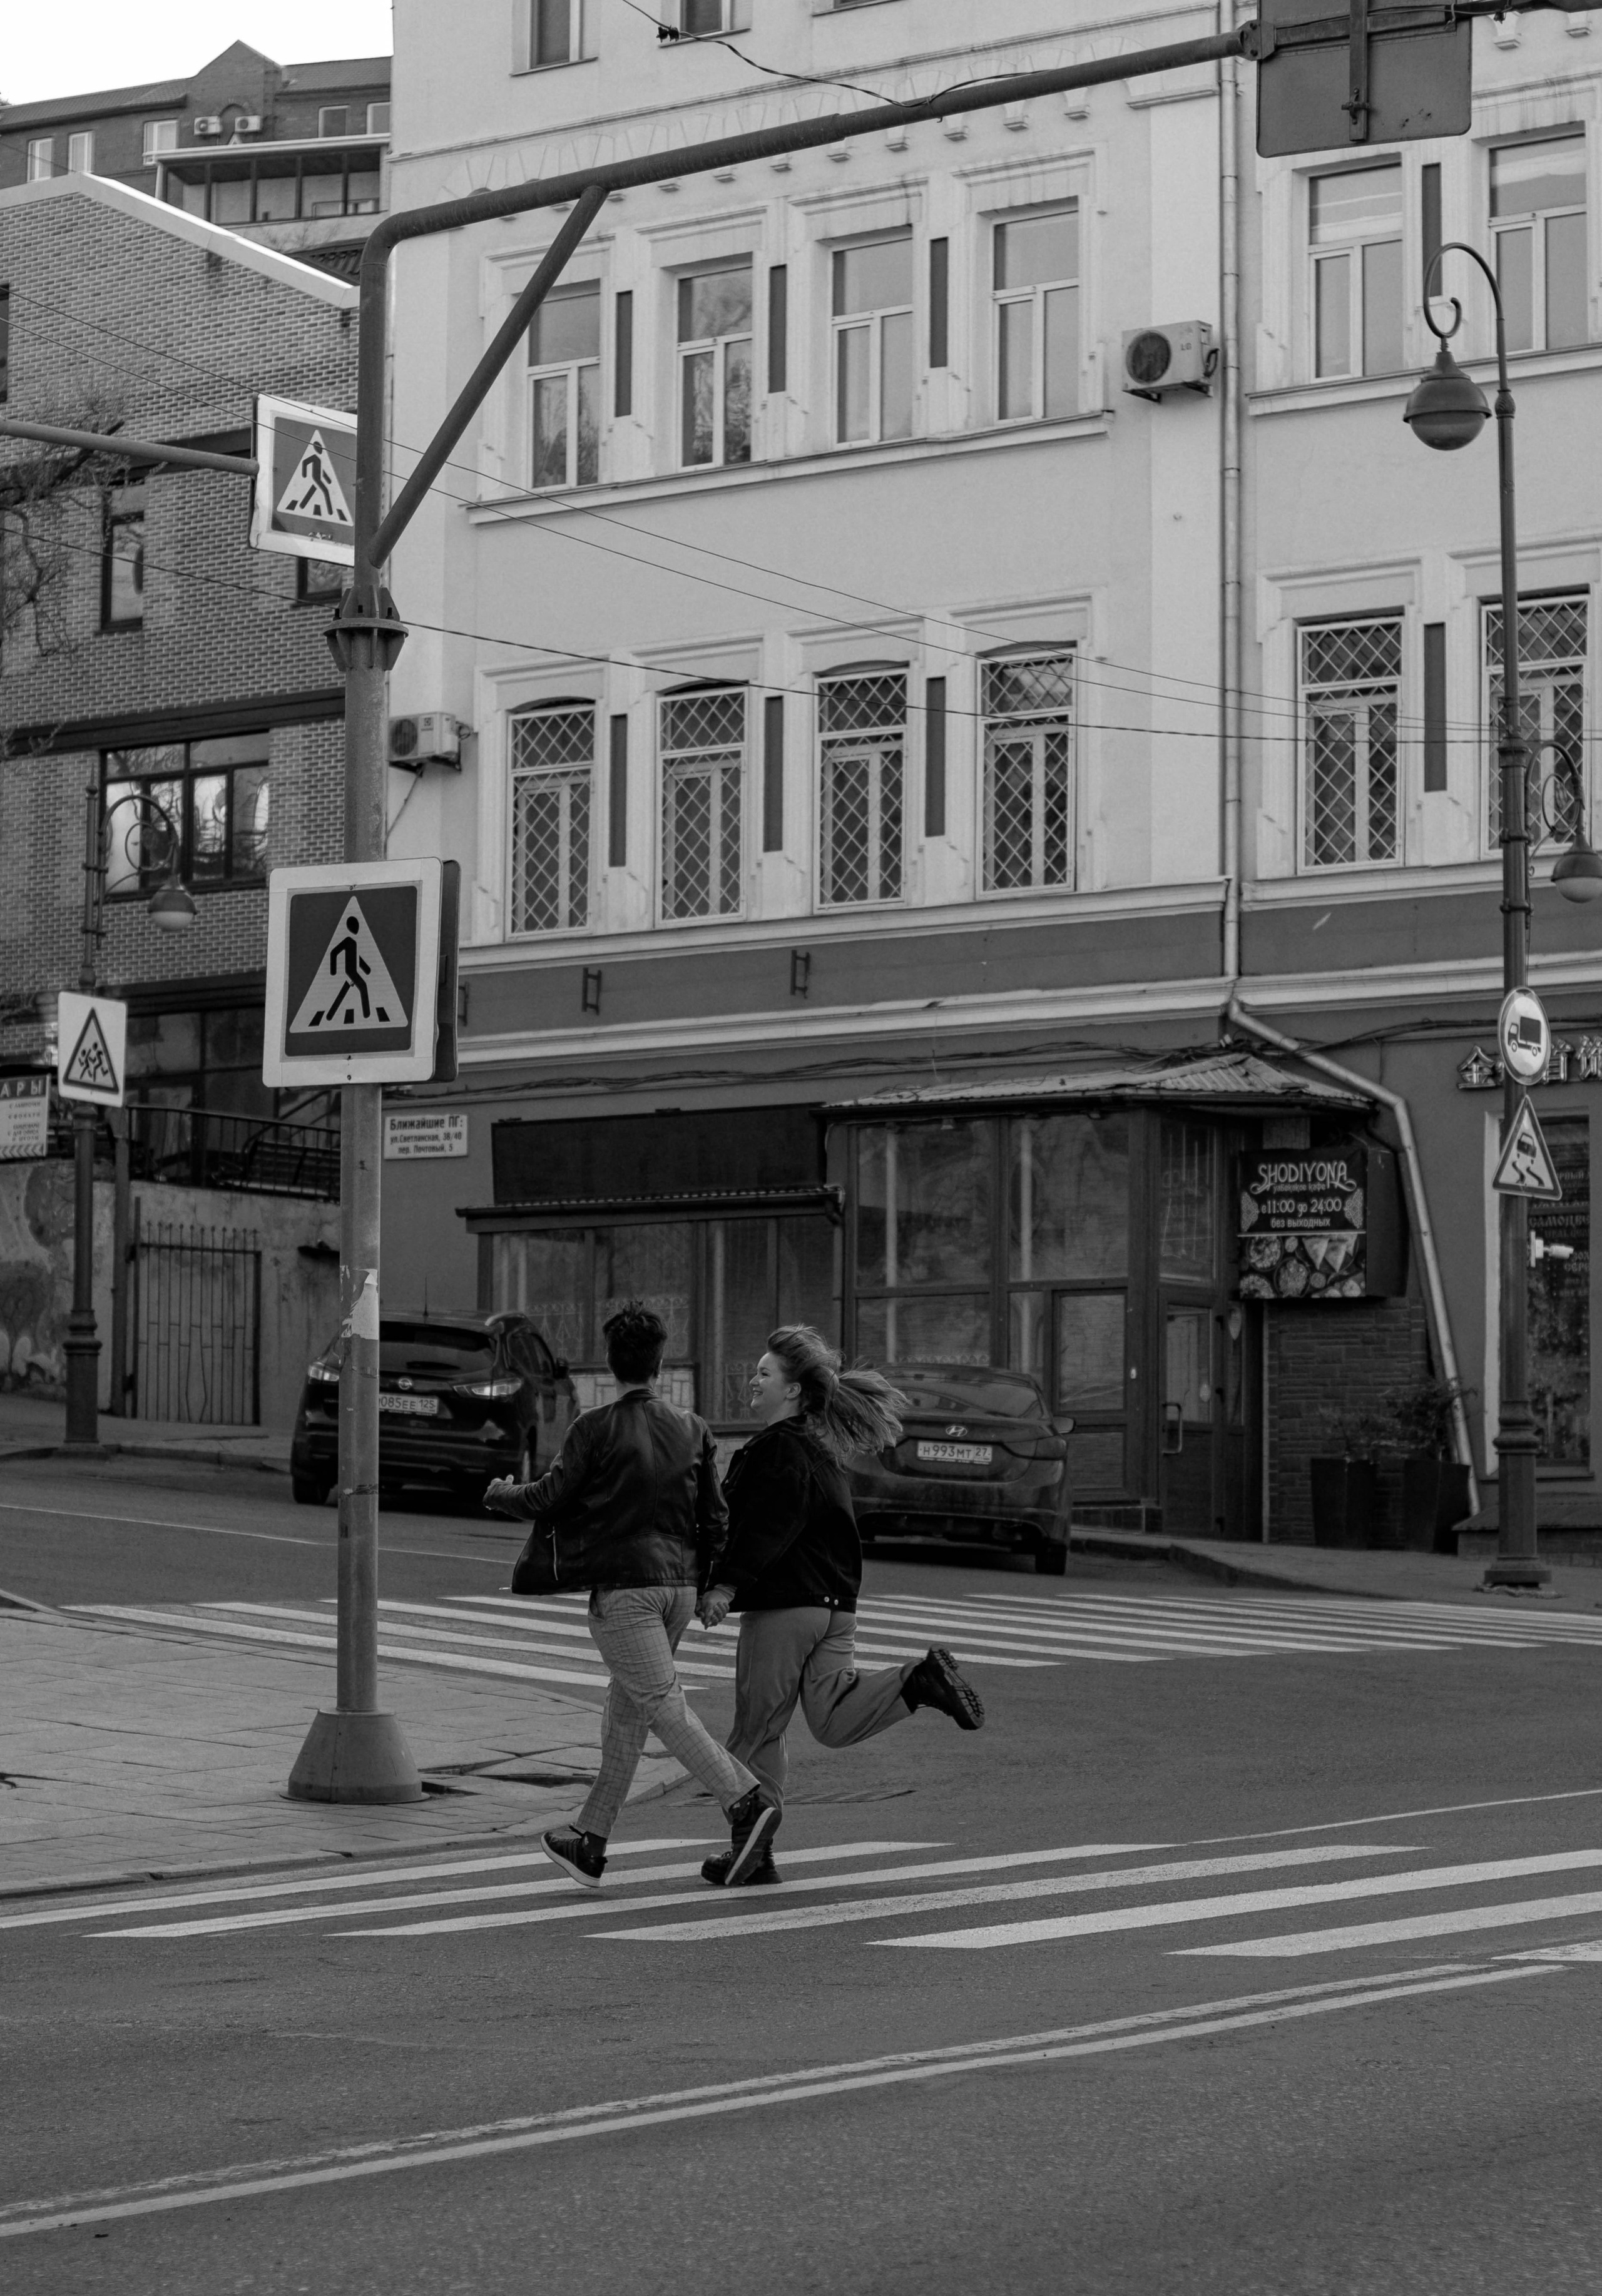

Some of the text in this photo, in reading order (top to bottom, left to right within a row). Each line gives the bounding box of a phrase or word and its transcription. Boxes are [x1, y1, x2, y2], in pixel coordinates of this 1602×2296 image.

[390, 1115, 463, 1130] Ближайшие ПГ:
[449, 1144, 453, 1152] 5
[1252, 1161, 1355, 1192] SHODIYONA
[1297, 1202, 1308, 1217] до
[1310, 1198, 1342, 1214] 24:00
[1271, 1217, 1330, 1228] без выходных
[379, 1396, 416, 1410] 085ЕЕ
